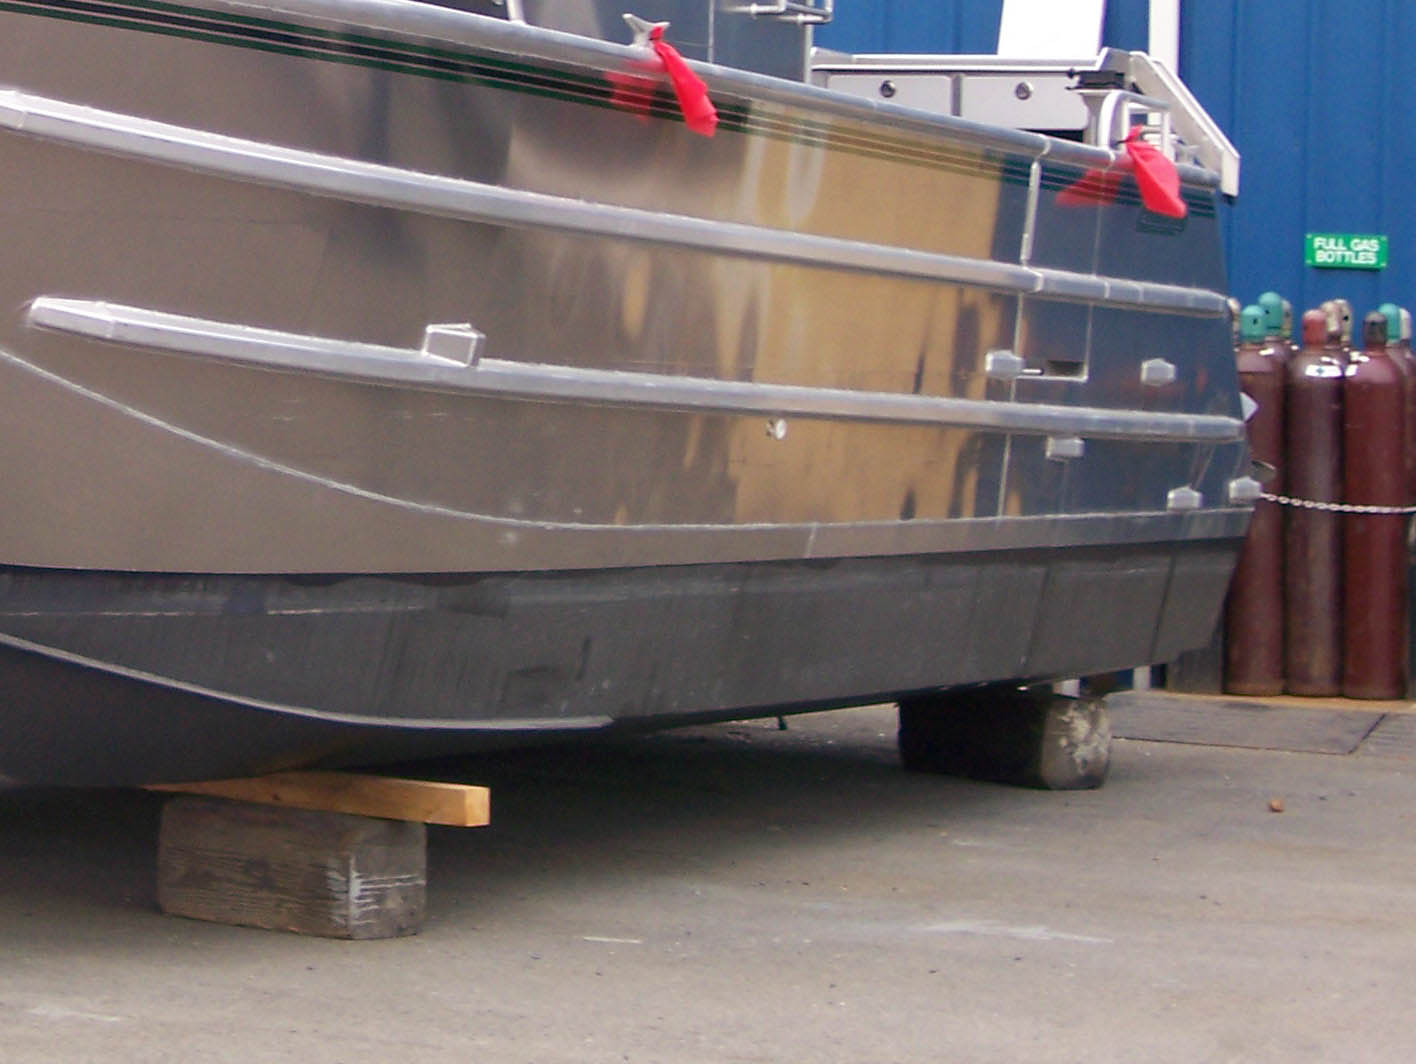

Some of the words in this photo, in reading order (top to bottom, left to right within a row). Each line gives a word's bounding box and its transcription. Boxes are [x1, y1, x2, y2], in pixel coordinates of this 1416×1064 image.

[1313, 237, 1348, 251] FULL
[1350, 239, 1380, 252] GAS
[1315, 250, 1377, 264] BOTTLES
